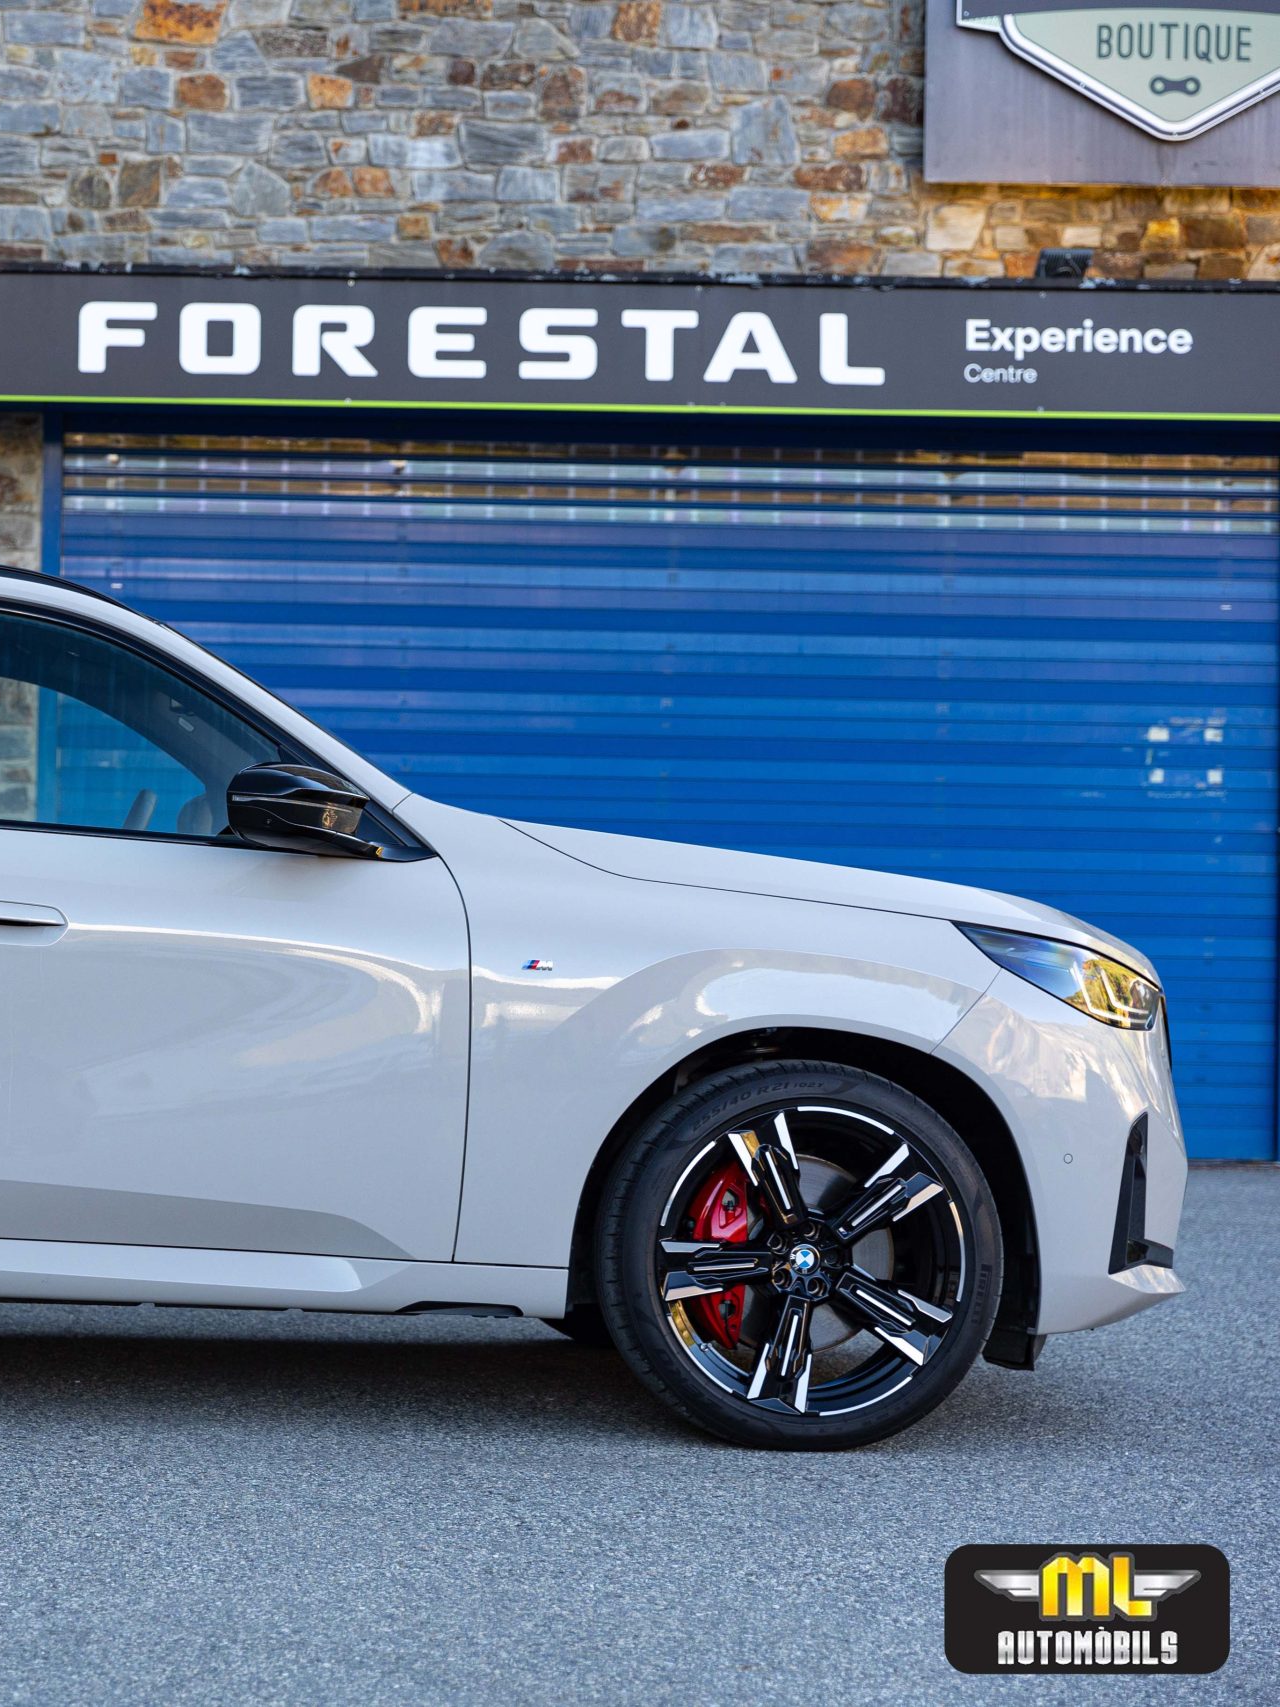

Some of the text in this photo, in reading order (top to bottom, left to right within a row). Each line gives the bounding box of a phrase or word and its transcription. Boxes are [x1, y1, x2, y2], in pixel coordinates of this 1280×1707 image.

[1097, 22, 1252, 63] BOUTIQUE
[77, 300, 886, 386] FORESTAL
[964, 316, 1194, 355] Experience
[962, 362, 1039, 384] Centre
[756, 1081, 791, 1096] R21
